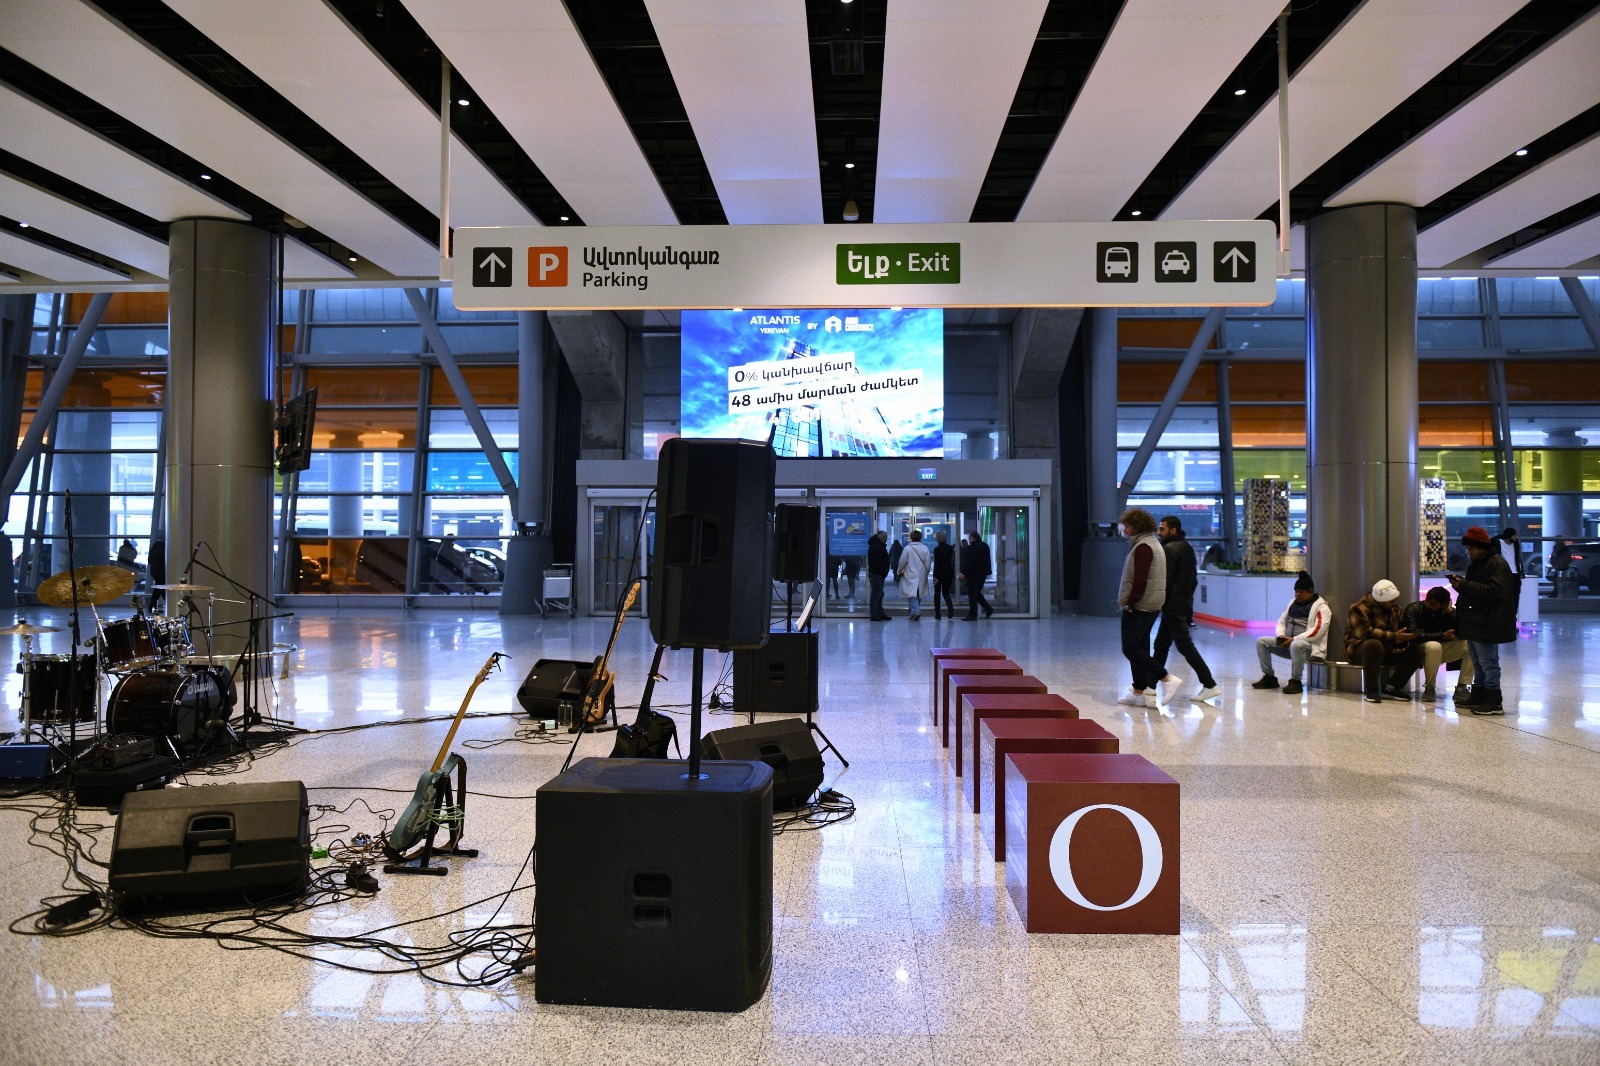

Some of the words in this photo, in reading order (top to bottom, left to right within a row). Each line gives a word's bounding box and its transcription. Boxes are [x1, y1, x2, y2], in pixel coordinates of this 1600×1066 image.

[539, 253, 560, 281] P
[583, 246, 720, 270] Ավտոկանգառ
[847, 250, 890, 278] Ելք
[908, 252, 950, 272] Exit
[583, 272, 648, 290] Parking
[750, 315, 800, 325] ATLANTIS
[807, 322, 818, 330] BY
[734, 370, 758, 383] 0%
[762, 360, 852, 380] կանխավճար
[731, 394, 751, 408] 48
[756, 391, 793, 405] ամիս
[798, 383, 856, 400] մարման
[860, 376, 919, 392] ժամկետ
[833, 519, 846, 535] P
[924, 526, 933, 539] P
[1048, 803, 1164, 912] O
